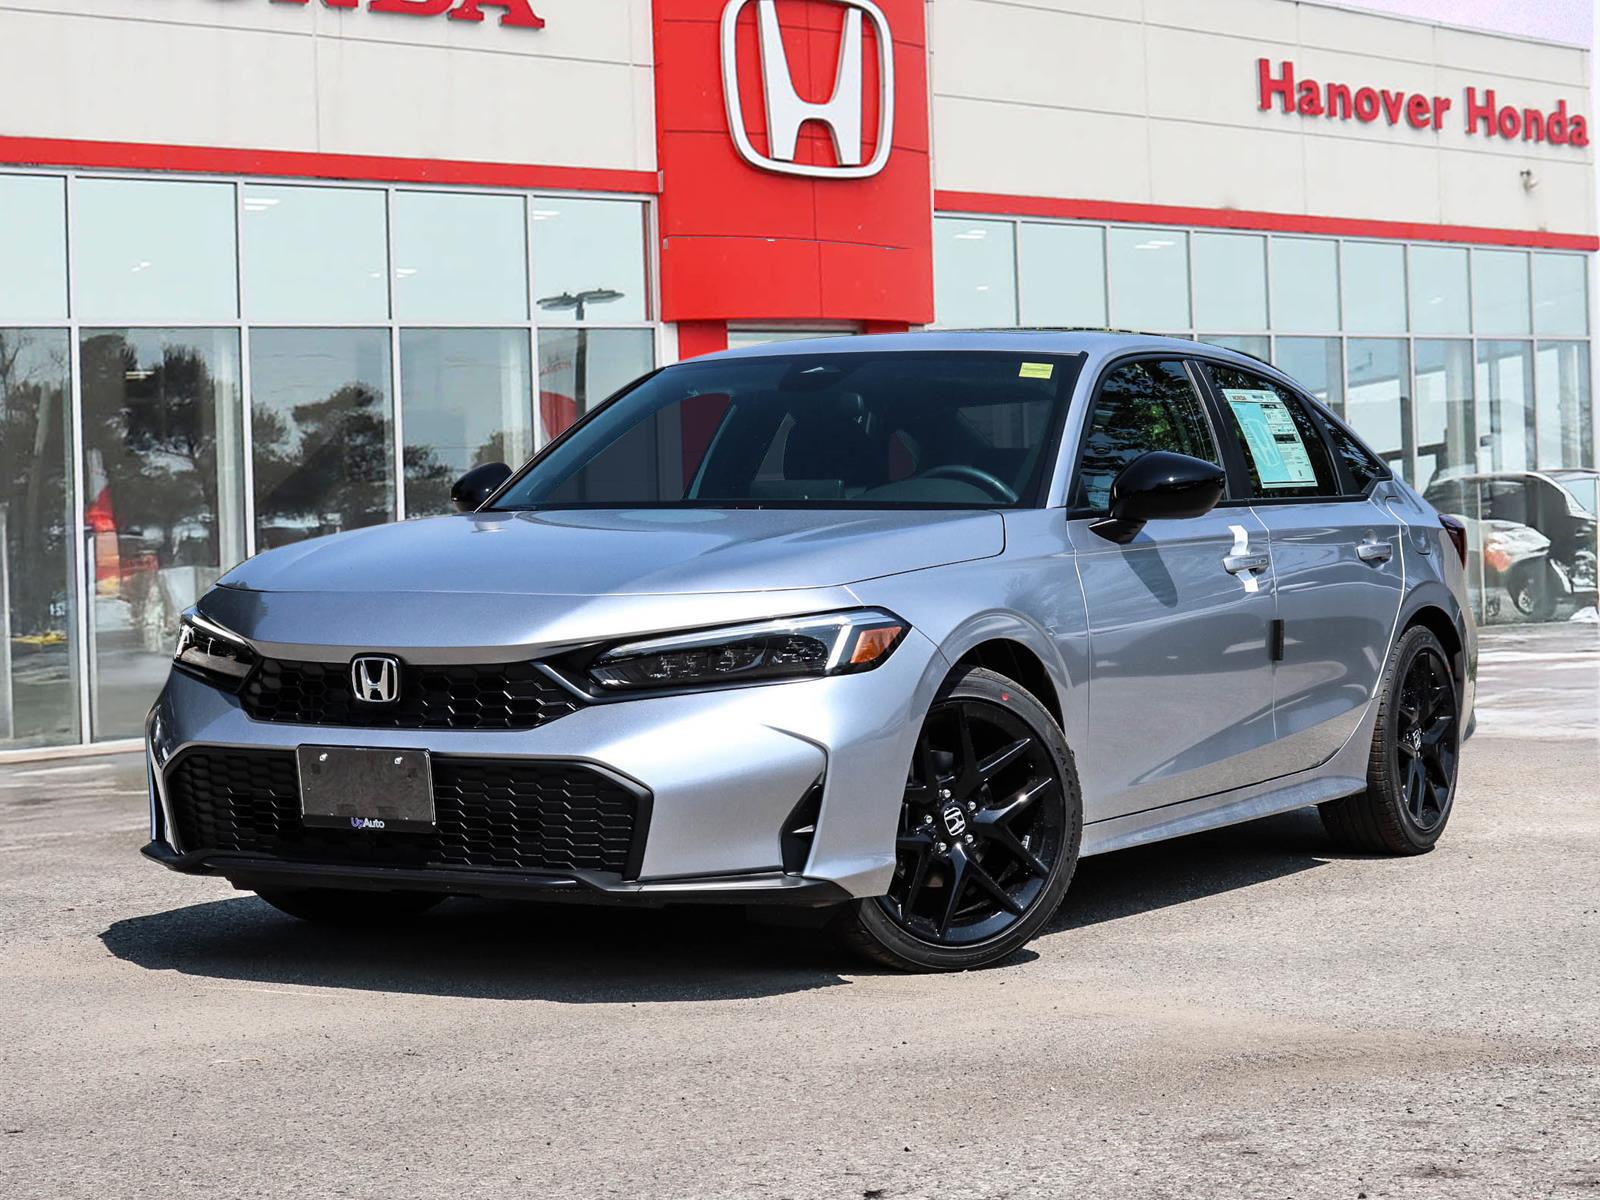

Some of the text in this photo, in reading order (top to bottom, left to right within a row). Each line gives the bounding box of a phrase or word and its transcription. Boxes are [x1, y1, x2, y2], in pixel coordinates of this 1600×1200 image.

[1257, 57, 1590, 147] Hanover Honda
[350, 816, 386, 830] UpAuto
